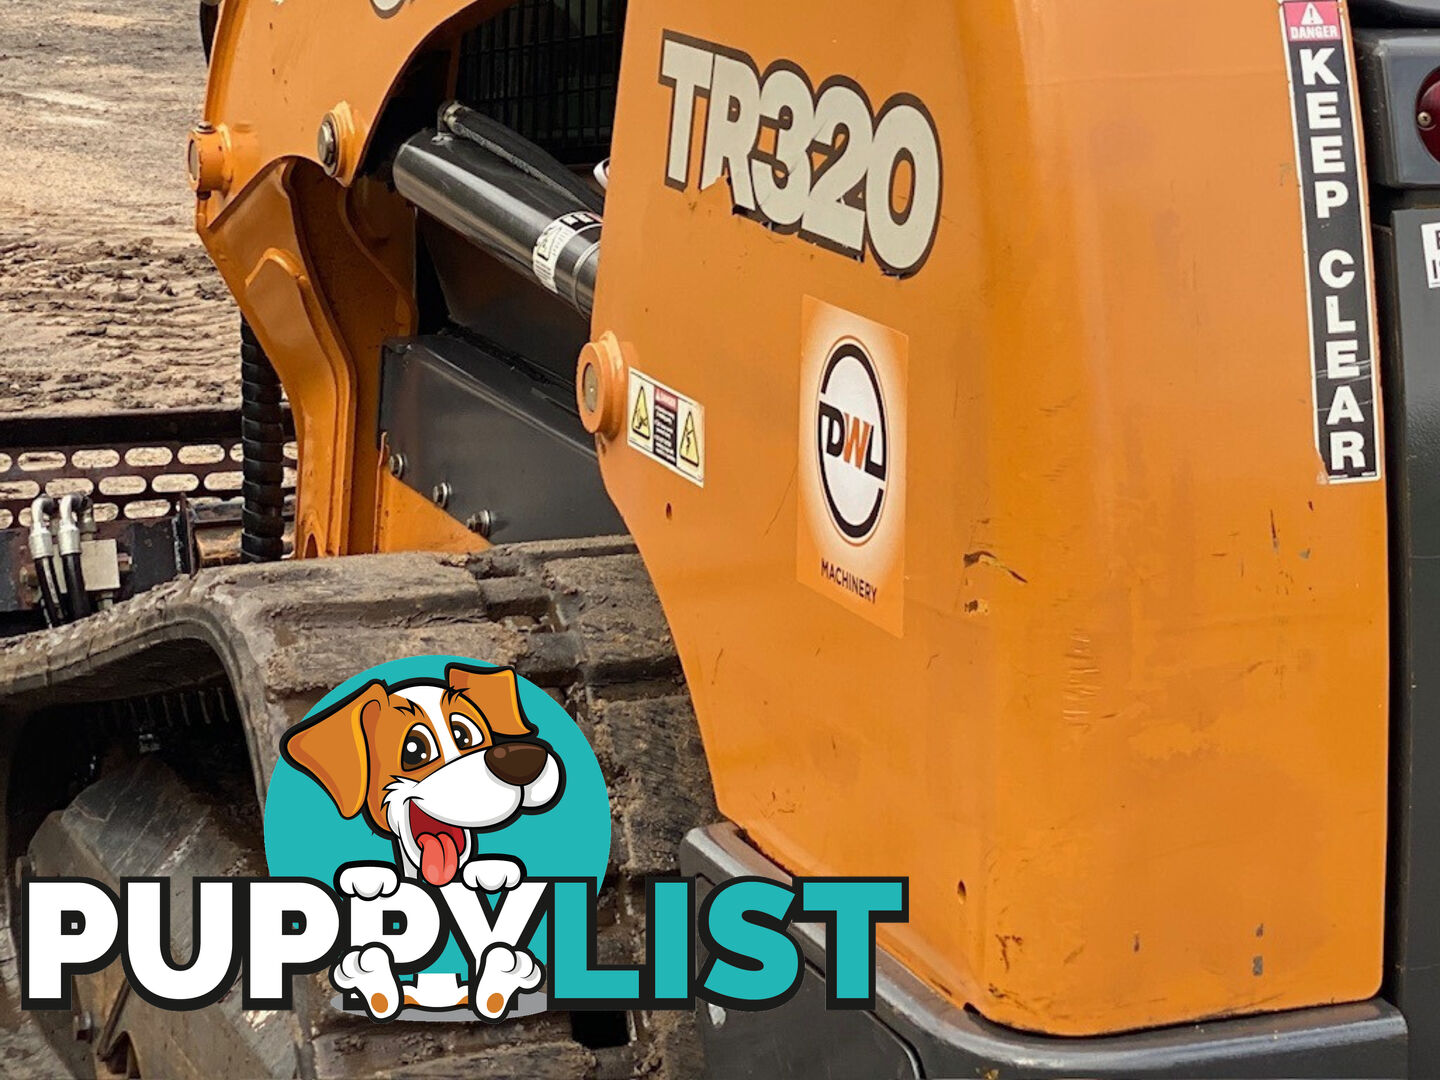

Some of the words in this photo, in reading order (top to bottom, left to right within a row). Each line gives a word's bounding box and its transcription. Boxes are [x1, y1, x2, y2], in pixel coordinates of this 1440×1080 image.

[1290, 25, 1338, 40] DANGER
[658, 29, 942, 279] TR320
[1299, 47, 1350, 219] KEEP
[1318, 249, 1367, 472] CLEAR
[819, 401, 886, 482] DWL
[820, 557, 878, 605] MACHINERY
